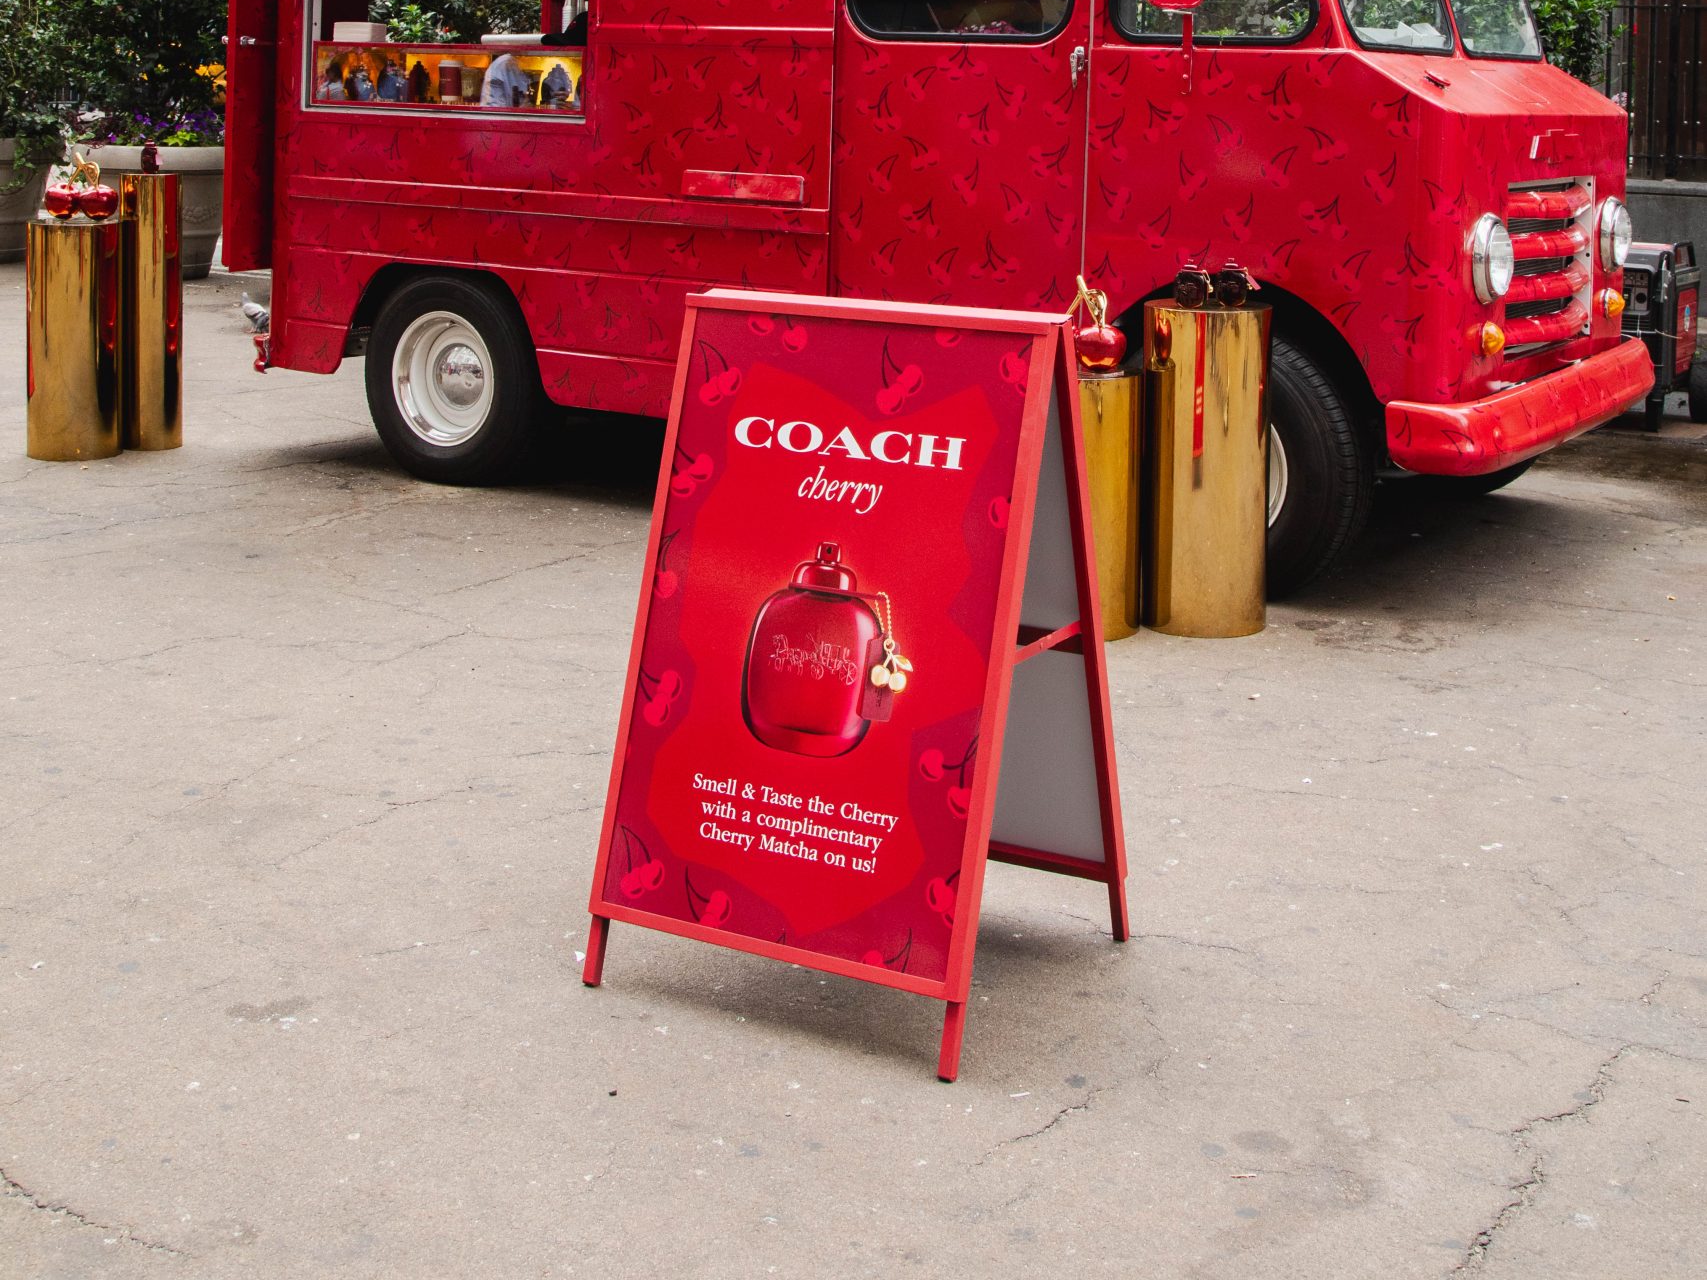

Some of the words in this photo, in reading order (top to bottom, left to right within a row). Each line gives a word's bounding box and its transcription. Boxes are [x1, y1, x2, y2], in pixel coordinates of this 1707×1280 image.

[734, 416, 967, 471] COACH
[797, 465, 883, 515] cherry
[693, 773, 738, 796] Smell
[741, 782, 756, 800] &
[760, 785, 803, 809] Taste
[808, 795, 835, 816] the
[840, 802, 899, 832] Cherry
[701, 800, 737, 820] with
[741, 810, 751, 823] a
[756, 813, 883, 854] complimentary
[699, 822, 755, 852] Cherry
[758, 833, 819, 861] Matcha
[823, 851, 846, 868] on
[851, 857, 877, 874] us!
